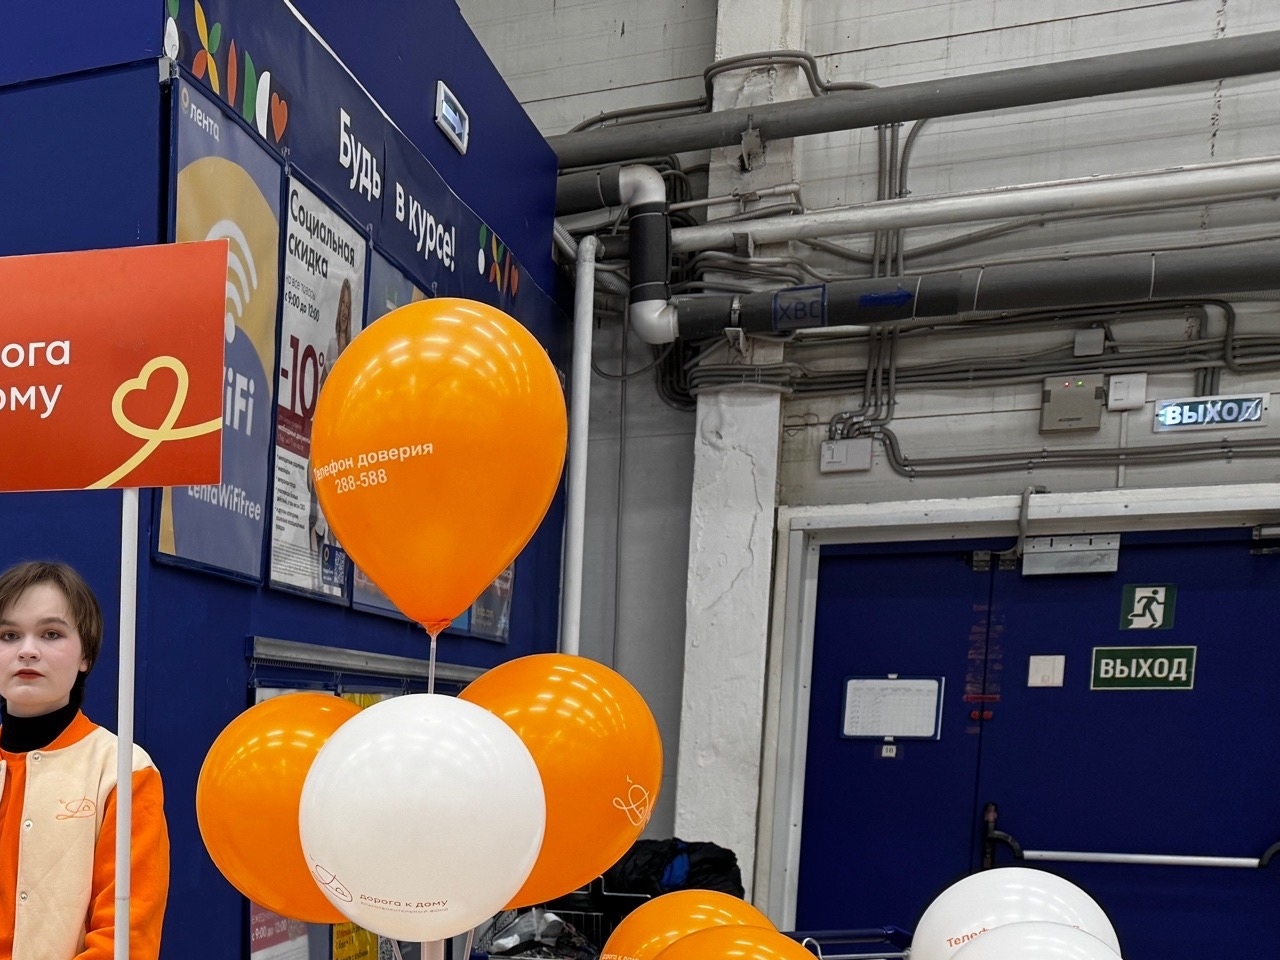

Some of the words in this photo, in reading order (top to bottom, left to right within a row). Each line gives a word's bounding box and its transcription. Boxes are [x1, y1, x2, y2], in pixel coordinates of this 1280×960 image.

[190, 103, 220, 142] лента
[340, 108, 381, 201] Будь
[396, 182, 405, 222] в
[409, 195, 456, 272] курсе!
[290, 189, 355, 267] Социальная
[288, 233, 329, 279] скидка
[222, 367, 255, 437] iFi
[1165, 398, 1261, 426] ВЫХОД
[357, 443, 433, 468] доверия
[335, 469, 387, 494] 288-588
[1100, 657, 1188, 682] ВЫХОД
[360, 894, 401, 906] дорога
[415, 899, 448, 908] дому
